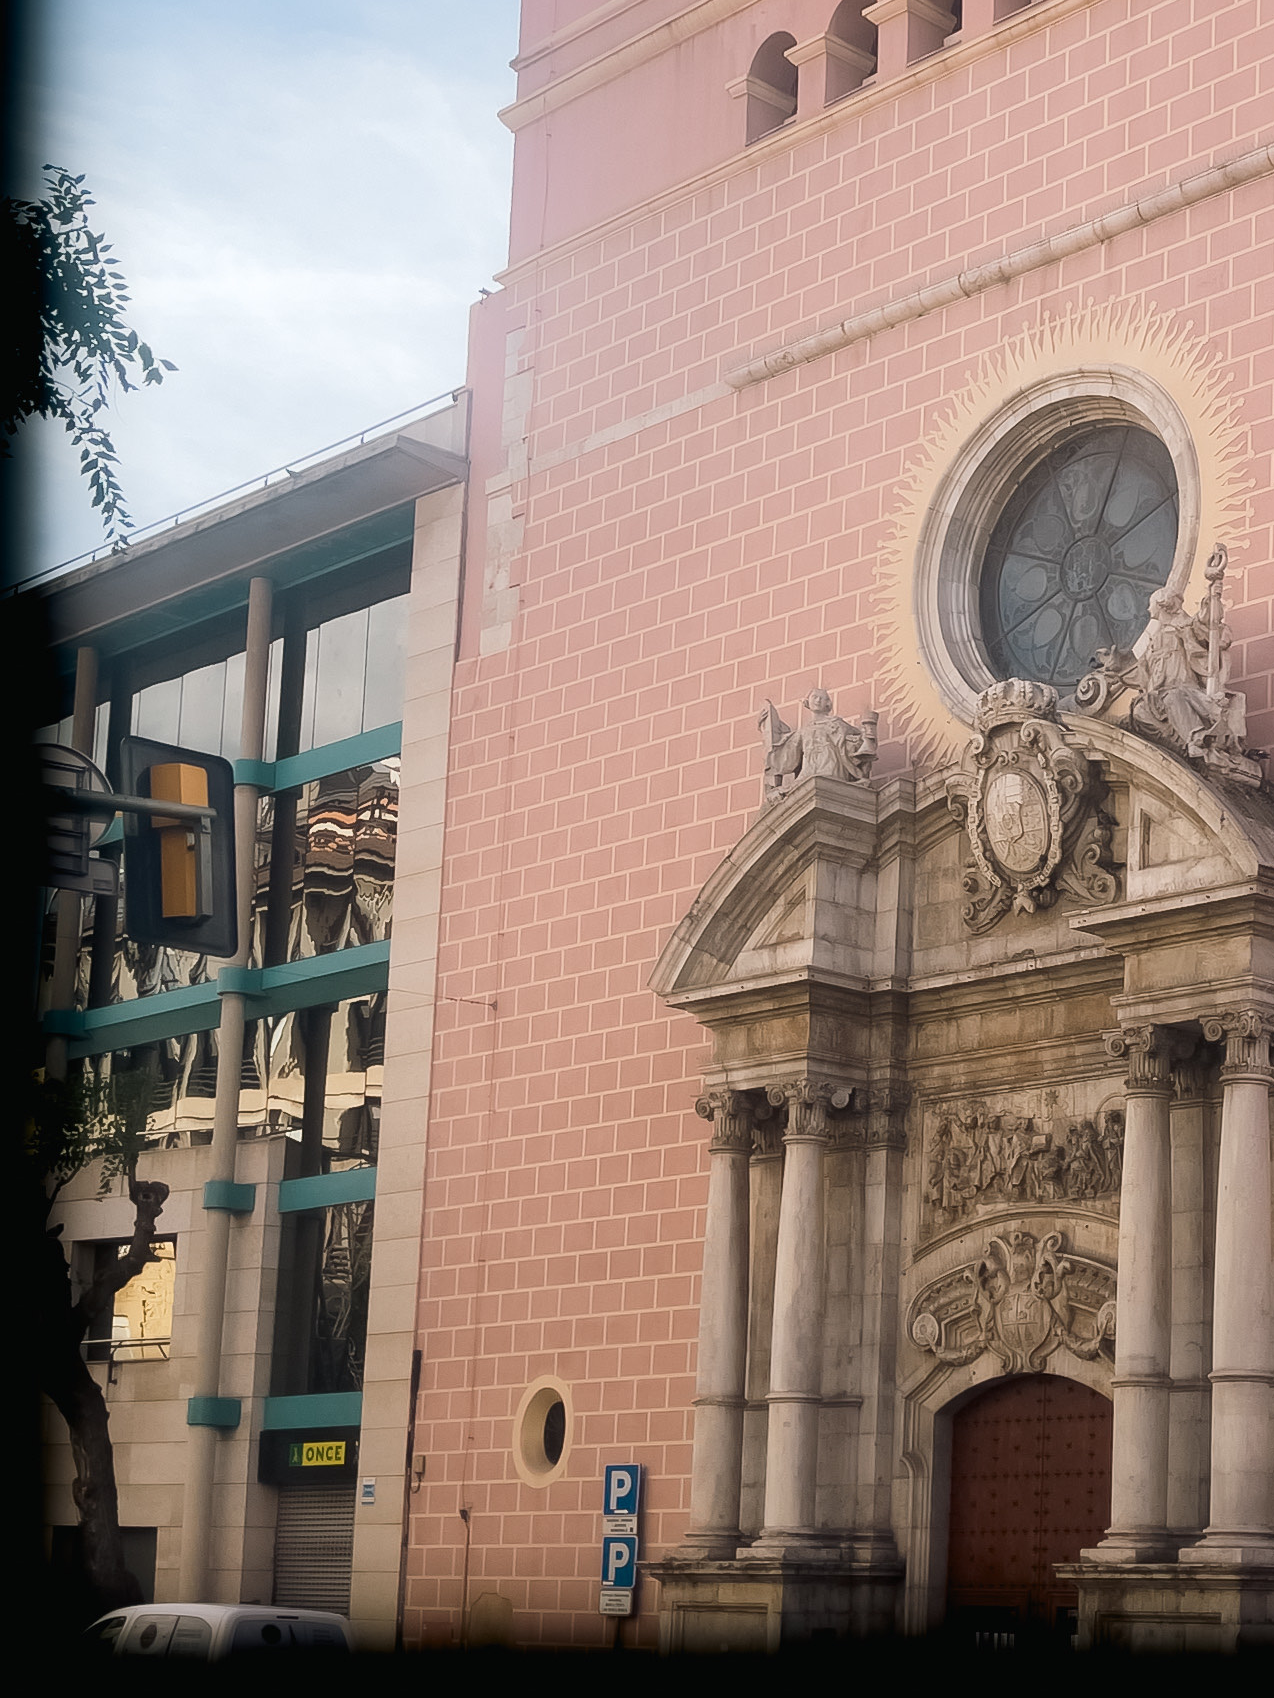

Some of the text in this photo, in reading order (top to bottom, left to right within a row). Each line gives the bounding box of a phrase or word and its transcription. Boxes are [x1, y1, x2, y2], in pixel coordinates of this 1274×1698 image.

[306, 1446, 342, 1462] ONCE
[610, 1470, 632, 1510] P
[608, 1542, 630, 1581] P
